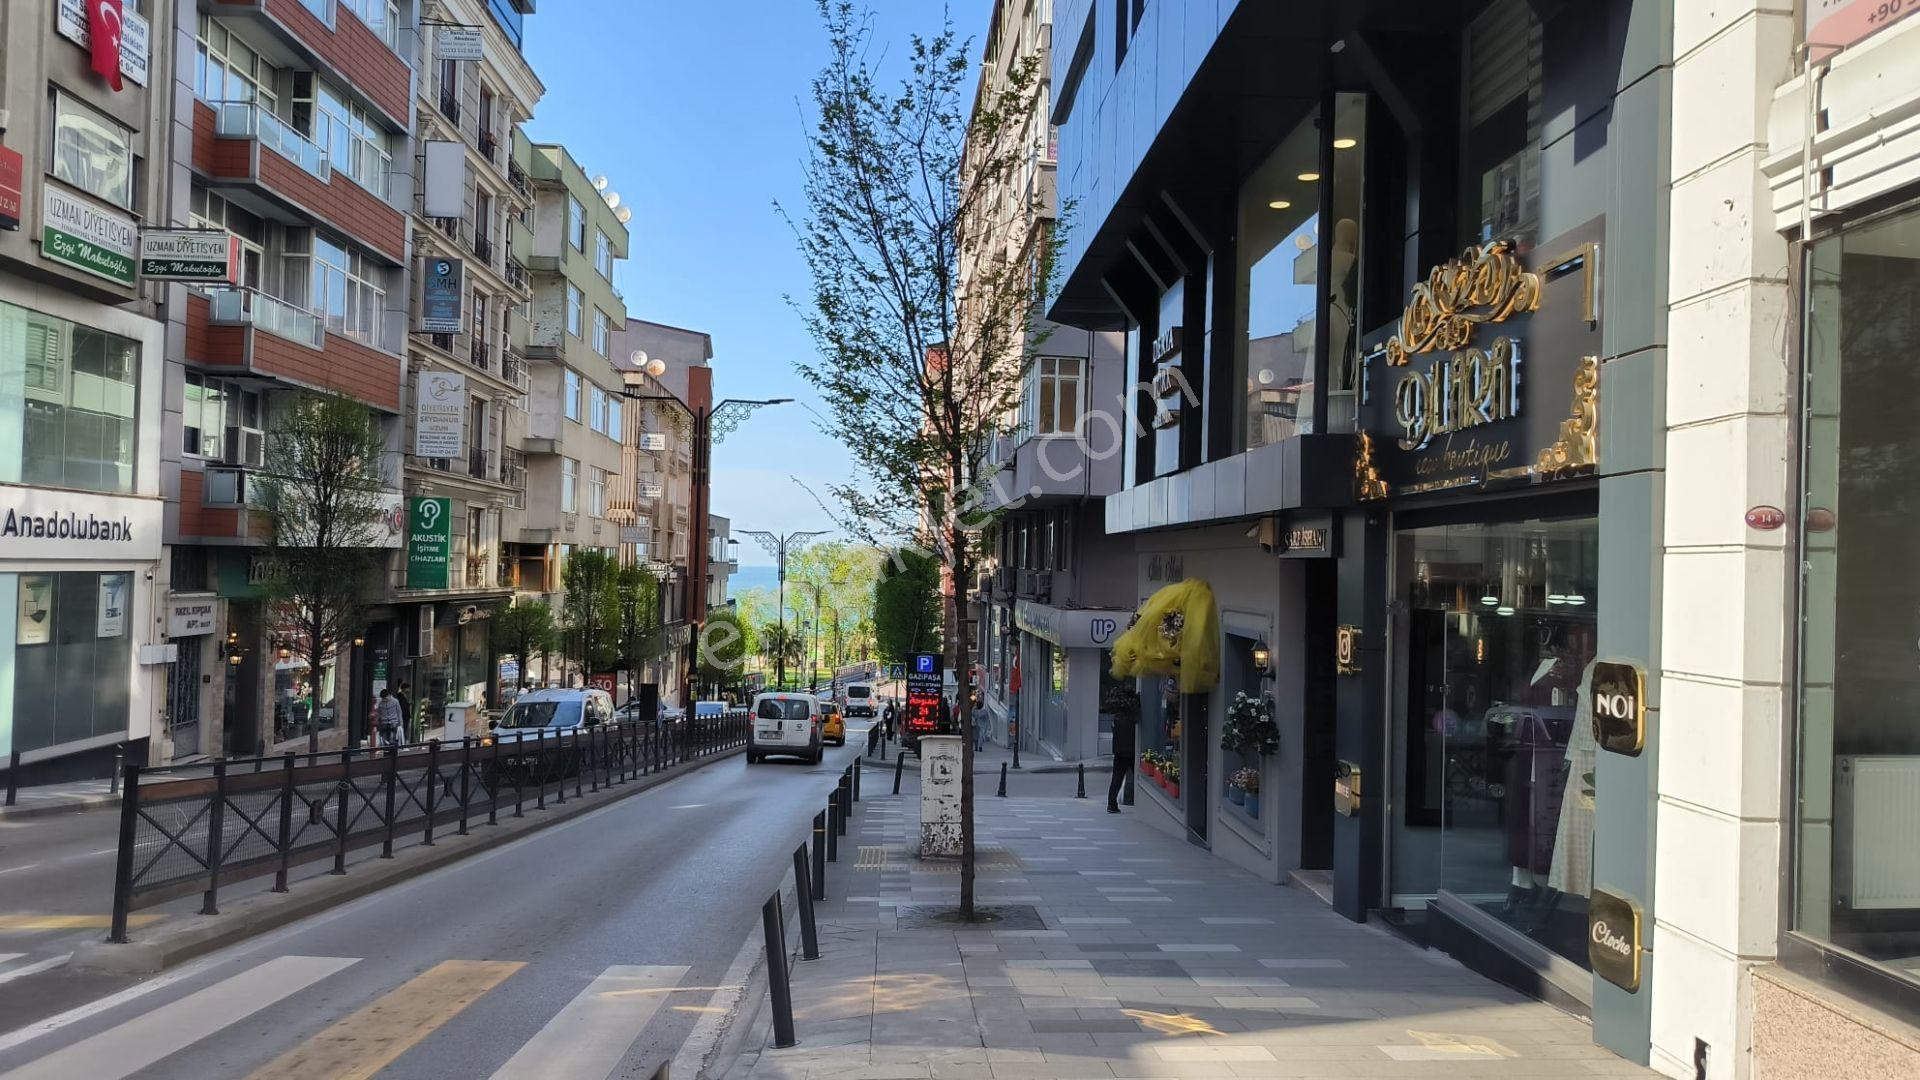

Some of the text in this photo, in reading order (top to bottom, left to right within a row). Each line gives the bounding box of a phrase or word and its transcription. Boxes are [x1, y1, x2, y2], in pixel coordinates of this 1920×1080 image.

[50, 196, 81, 227] UZMAN
[147, 240, 175, 253] UZMAN
[53, 234, 75, 257] Ezgi
[78, 243, 128, 275] Makuloğlu
[147, 261, 222, 276] Ezgi Makuloğlu
[1, 507, 133, 542] Anadolubank
[1762, 513, 1772, 523] 14
[411, 533, 447, 544] AKUSTİK
[417, 543, 440, 554] İŞİTME
[410, 553, 446, 563] CİHAZLARI
[920, 657, 930, 671] P
[908, 673, 942, 682] GAZİPAŞA
[1592, 920, 1632, 956] Cloche
